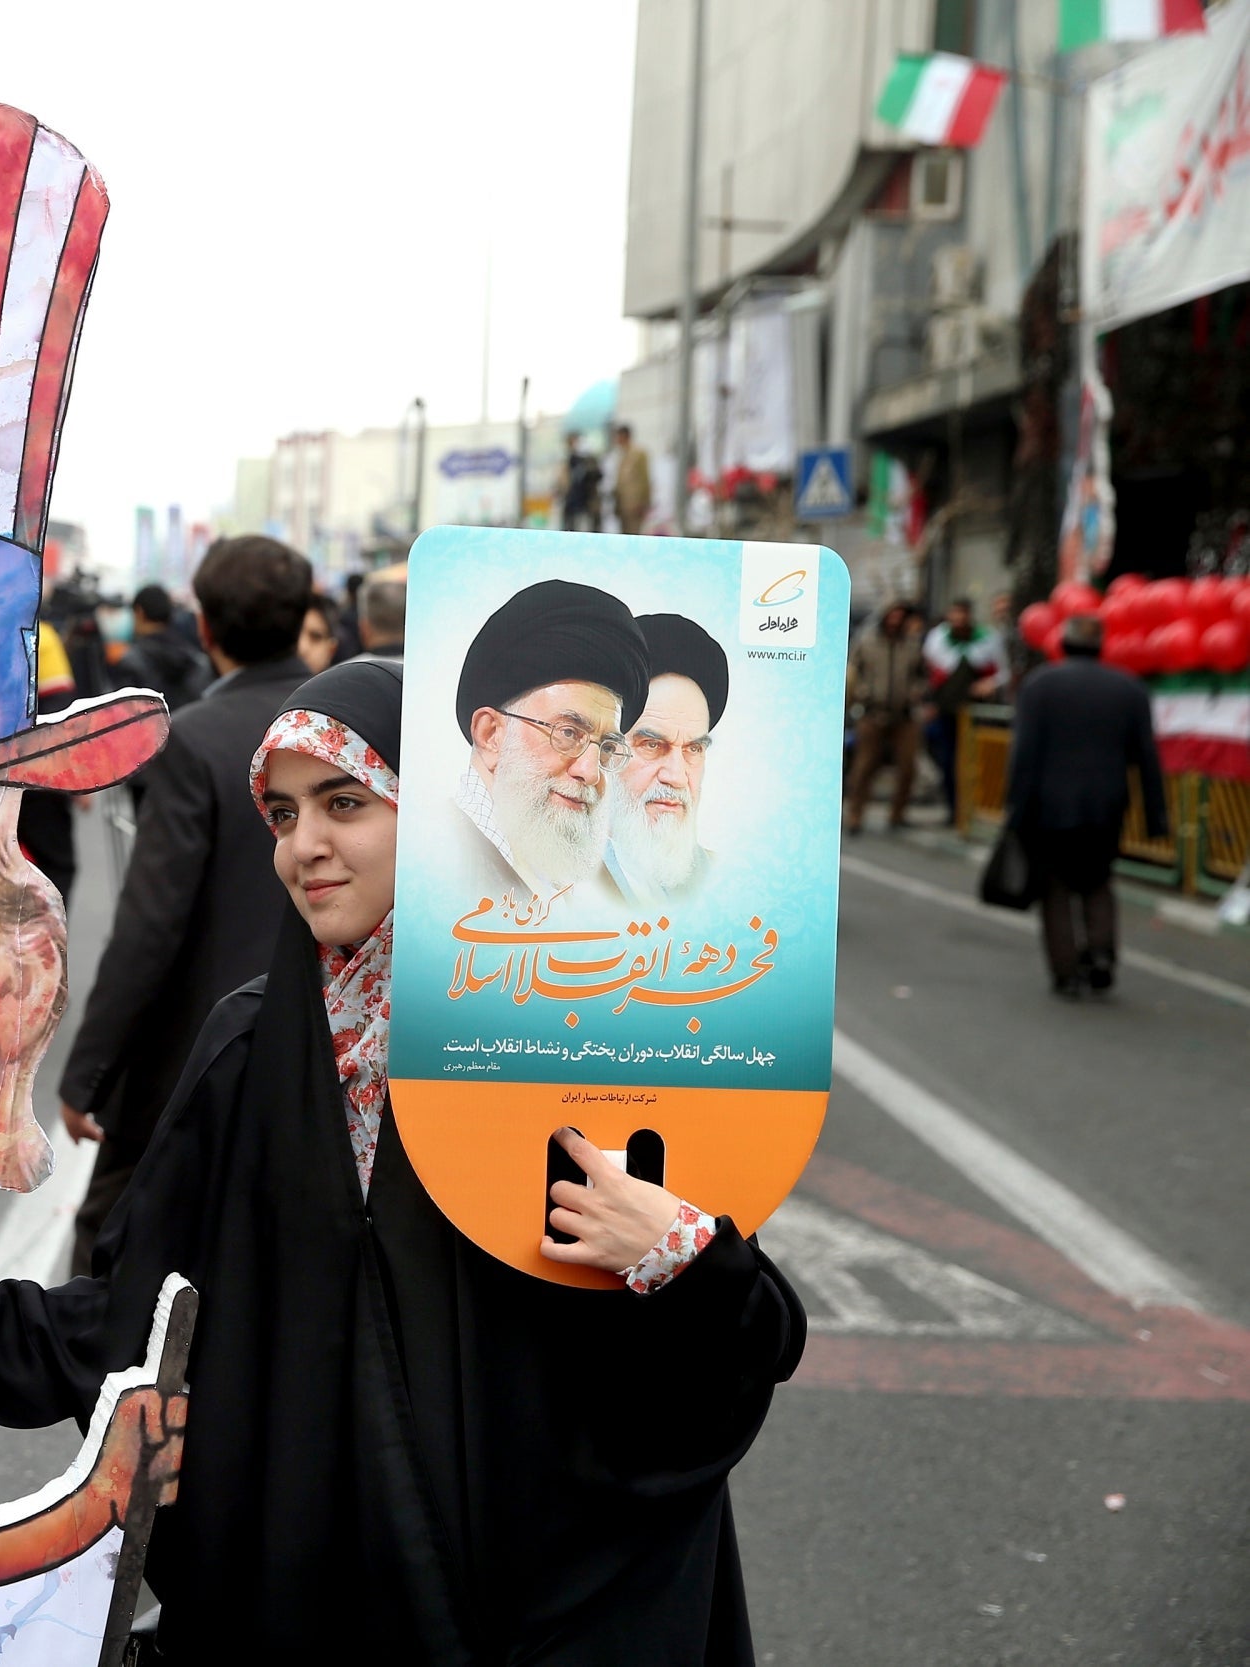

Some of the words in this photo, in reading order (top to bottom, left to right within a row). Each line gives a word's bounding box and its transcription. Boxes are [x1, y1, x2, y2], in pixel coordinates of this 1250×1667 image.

[758, 615, 780, 632] اول
[747, 650, 807, 662] www.mci.ir
[498, 887, 516, 918] باد
[447, 896, 621, 1002] اسلامی
[512, 914, 672, 1029] انقلاب
[612, 914, 779, 1035] فجر
[443, 1037, 480, 1053] است.
[481, 1037, 523, 1057] انقلاب
[524, 1039, 561, 1056] نشاط
[561, 1046, 569, 1060] و
[570, 1040, 616, 1062] پختگی
[617, 1042, 654, 1063] دوران
[700, 1044, 745, 1065] سالگی
[745, 1046, 776, 1067] چهل
[443, 1061, 466, 1072] رهبری
[466, 1060, 486, 1071] معظم
[486, 1060, 501, 1072] مقام
[561, 1092, 581, 1104] ایران
[581, 1092, 599, 1104] سیار
[599, 1092, 631, 1105] ارتباطات
[632, 1093, 657, 1105] شرکت
